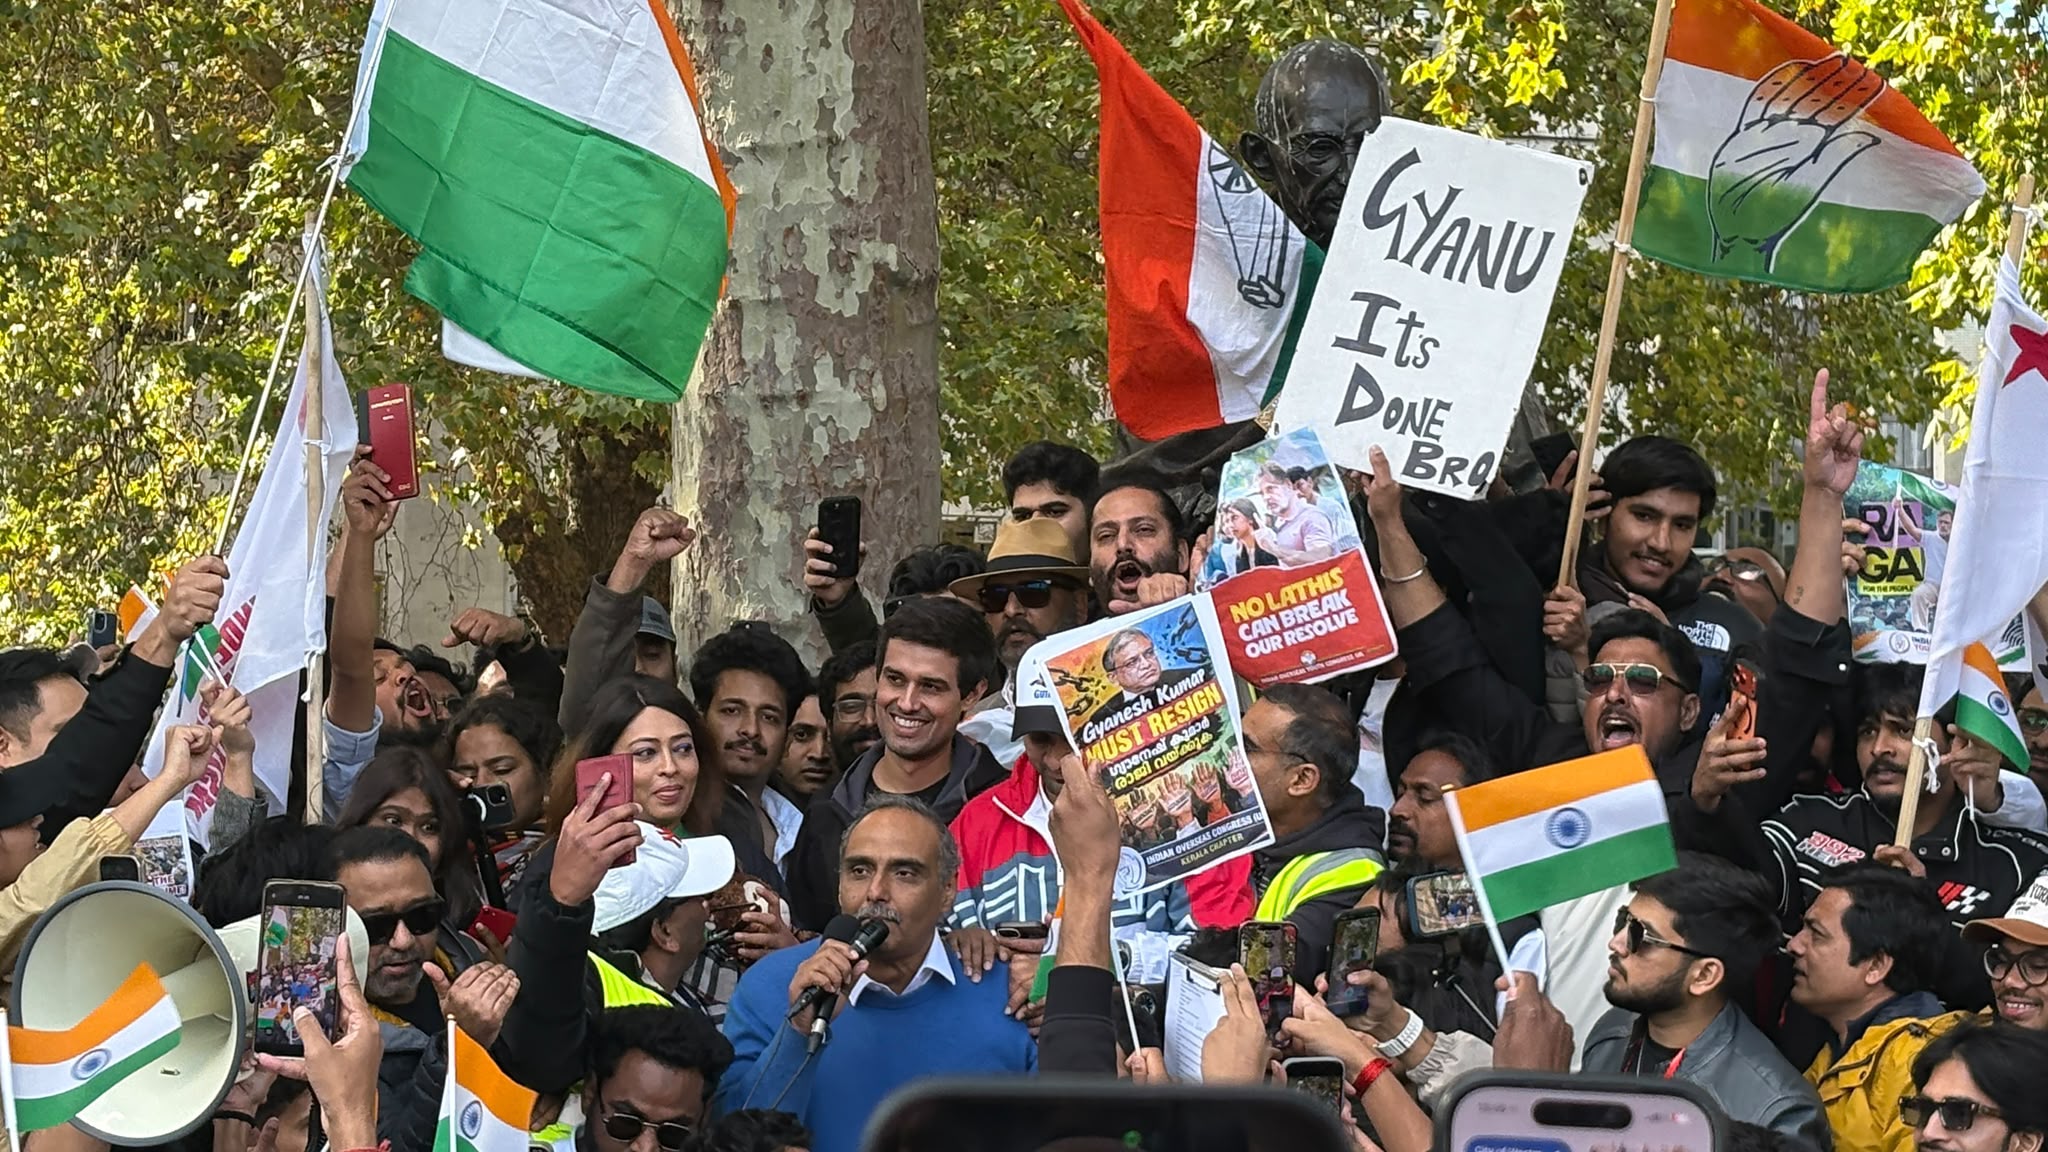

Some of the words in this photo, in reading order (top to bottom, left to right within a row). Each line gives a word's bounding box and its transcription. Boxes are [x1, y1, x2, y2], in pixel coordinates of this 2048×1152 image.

[1362, 147, 1556, 293] GYANU
[1334, 362, 1453, 442] DONE
[1401, 440, 1496, 487] BRO
[1859, 504, 1918, 542] RA
[1858, 546, 1924, 583] GA
[1229, 595, 1264, 624] NO
[1265, 567, 1344, 611] LATHIS
[1238, 613, 1280, 642] CAN
[1281, 588, 1352, 628] BREAK
[1245, 632, 1286, 658] OUR
[1286, 608, 1359, 648] RESOLVE
[1082, 694, 1155, 745] Gyanesh
[1085, 722, 1146, 766] MUST
[1148, 684, 1222, 738] RESIGN
[1146, 846, 1175, 865] INDIAN
[1176, 832, 1211, 855] OVERSEAS
[1212, 818, 1252, 840] CONGRESS
[1181, 850, 1208, 866] KERALA
[1210, 833, 1244, 852] CHAPTER
